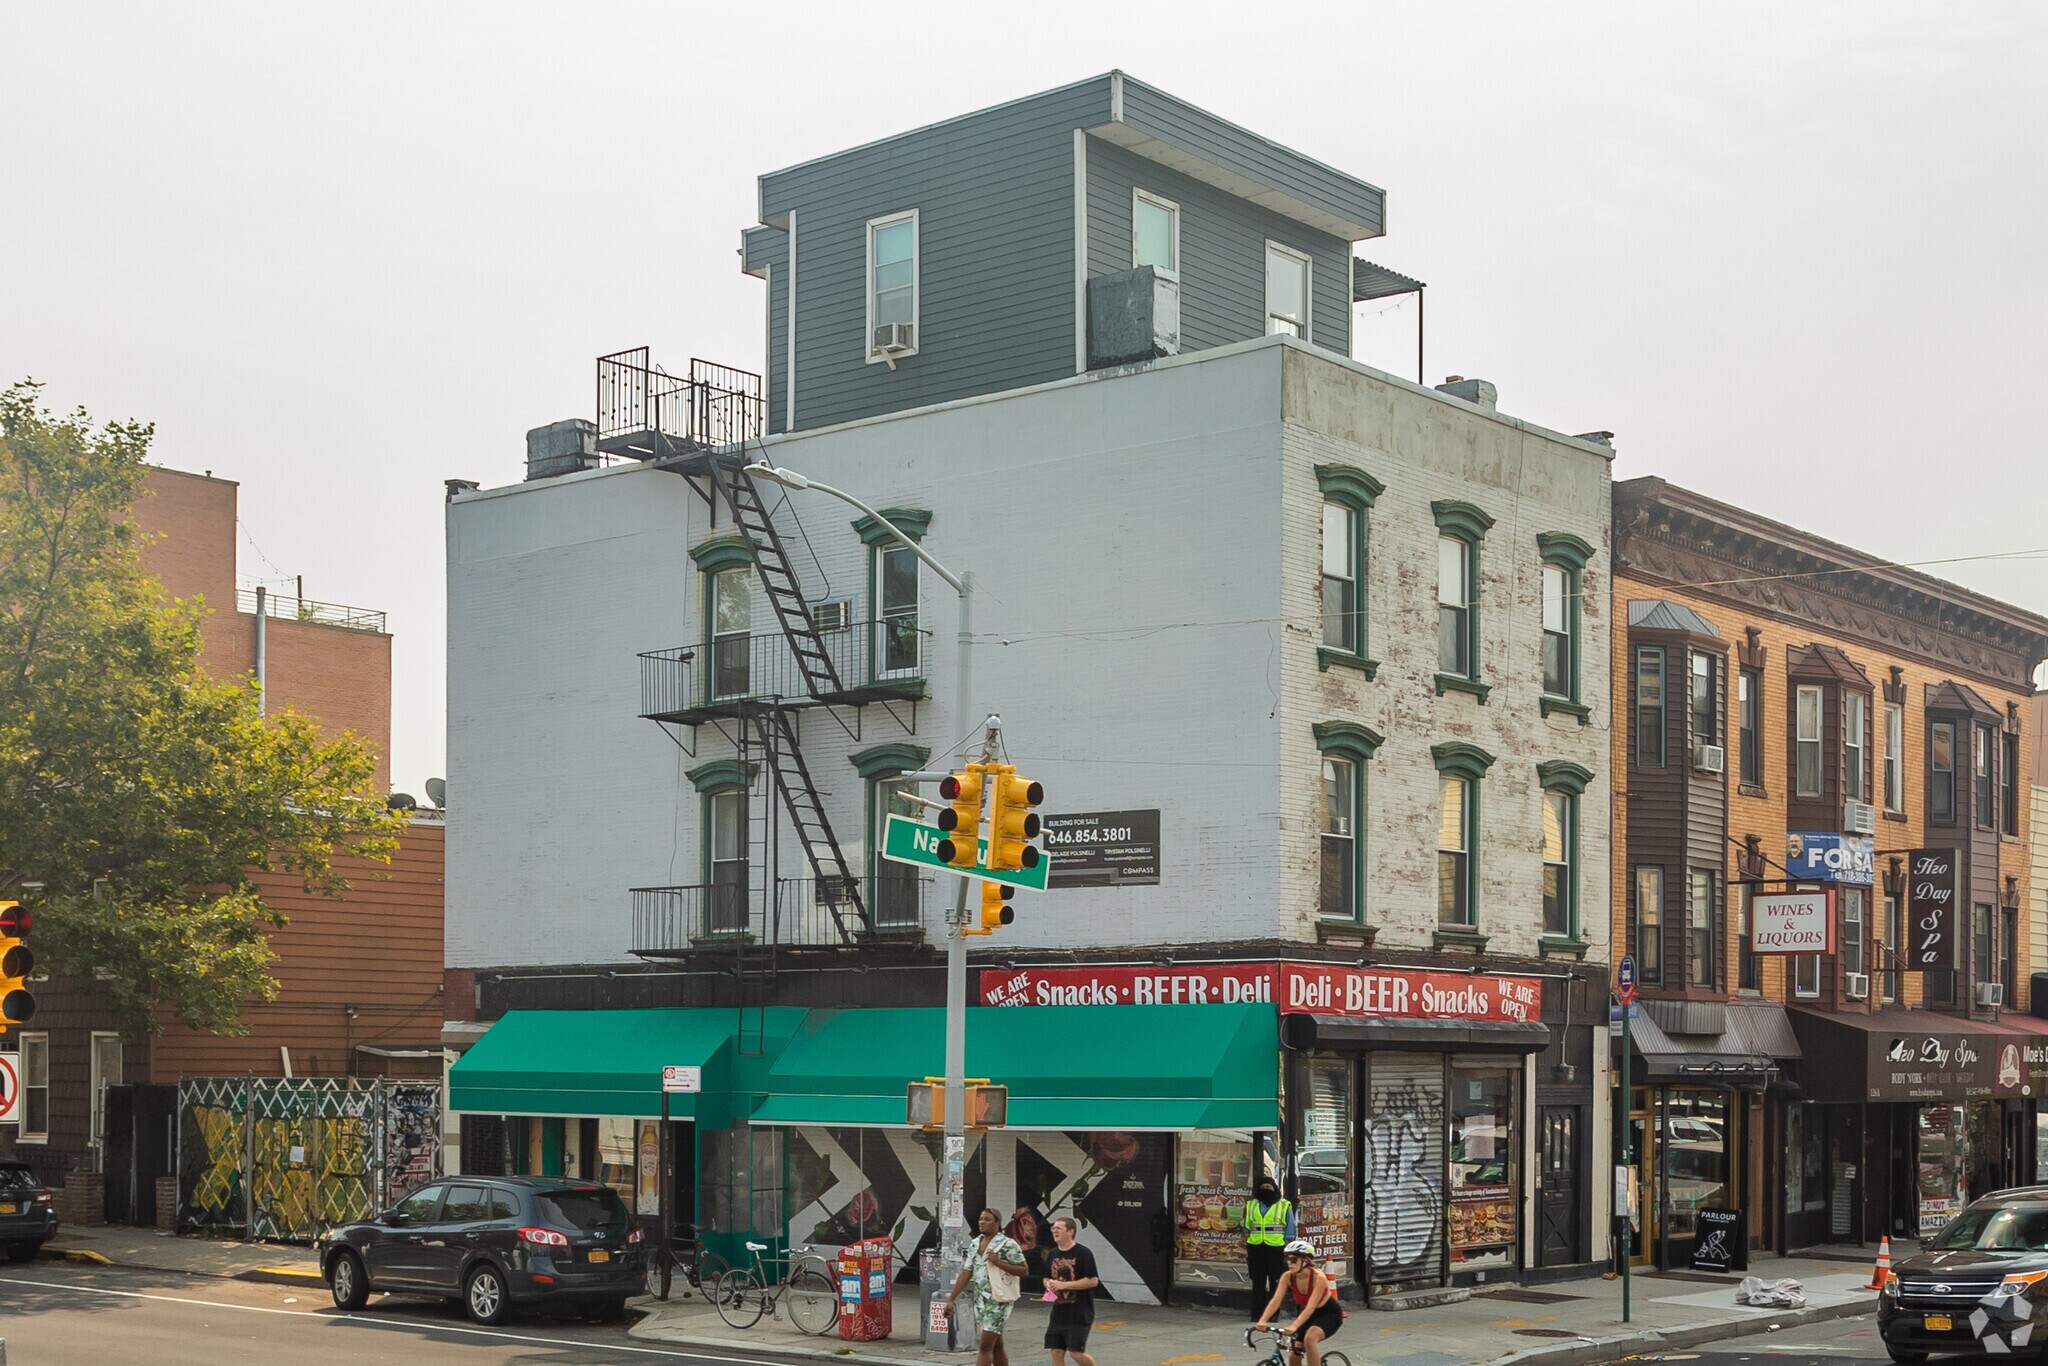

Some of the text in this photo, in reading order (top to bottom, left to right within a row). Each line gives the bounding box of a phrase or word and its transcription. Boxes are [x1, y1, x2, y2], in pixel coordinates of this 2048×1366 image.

[1074, 818, 1085, 826] FOR
[1048, 827, 1131, 844] 646.854.3801
[1808, 847, 1852, 869] FOR
[1122, 866, 1154, 874] COMPASS
[1913, 881, 1952, 904] Day
[1767, 903, 1813, 917] WINES
[1783, 918, 1796, 930] &
[1757, 930, 1823, 947] LIQUORS
[986, 971, 1031, 1005] WE ARE
[1036, 975, 1271, 1006] Snacks BEER Deli
[1289, 974, 1489, 1015] Deli BEER Snacks
[1498, 978, 1535, 1005] WE ARE
[1501, 998, 1528, 1019] OPEN
[2022, 1045, 2044, 1063] Moe's
[1701, 1211, 1737, 1221] PARLOUR
[1305, 1225, 1330, 1233] VARIETY
[1298, 1233, 1348, 1246] RAFT BEER
[1323, 1246, 1344, 1256] HERE
